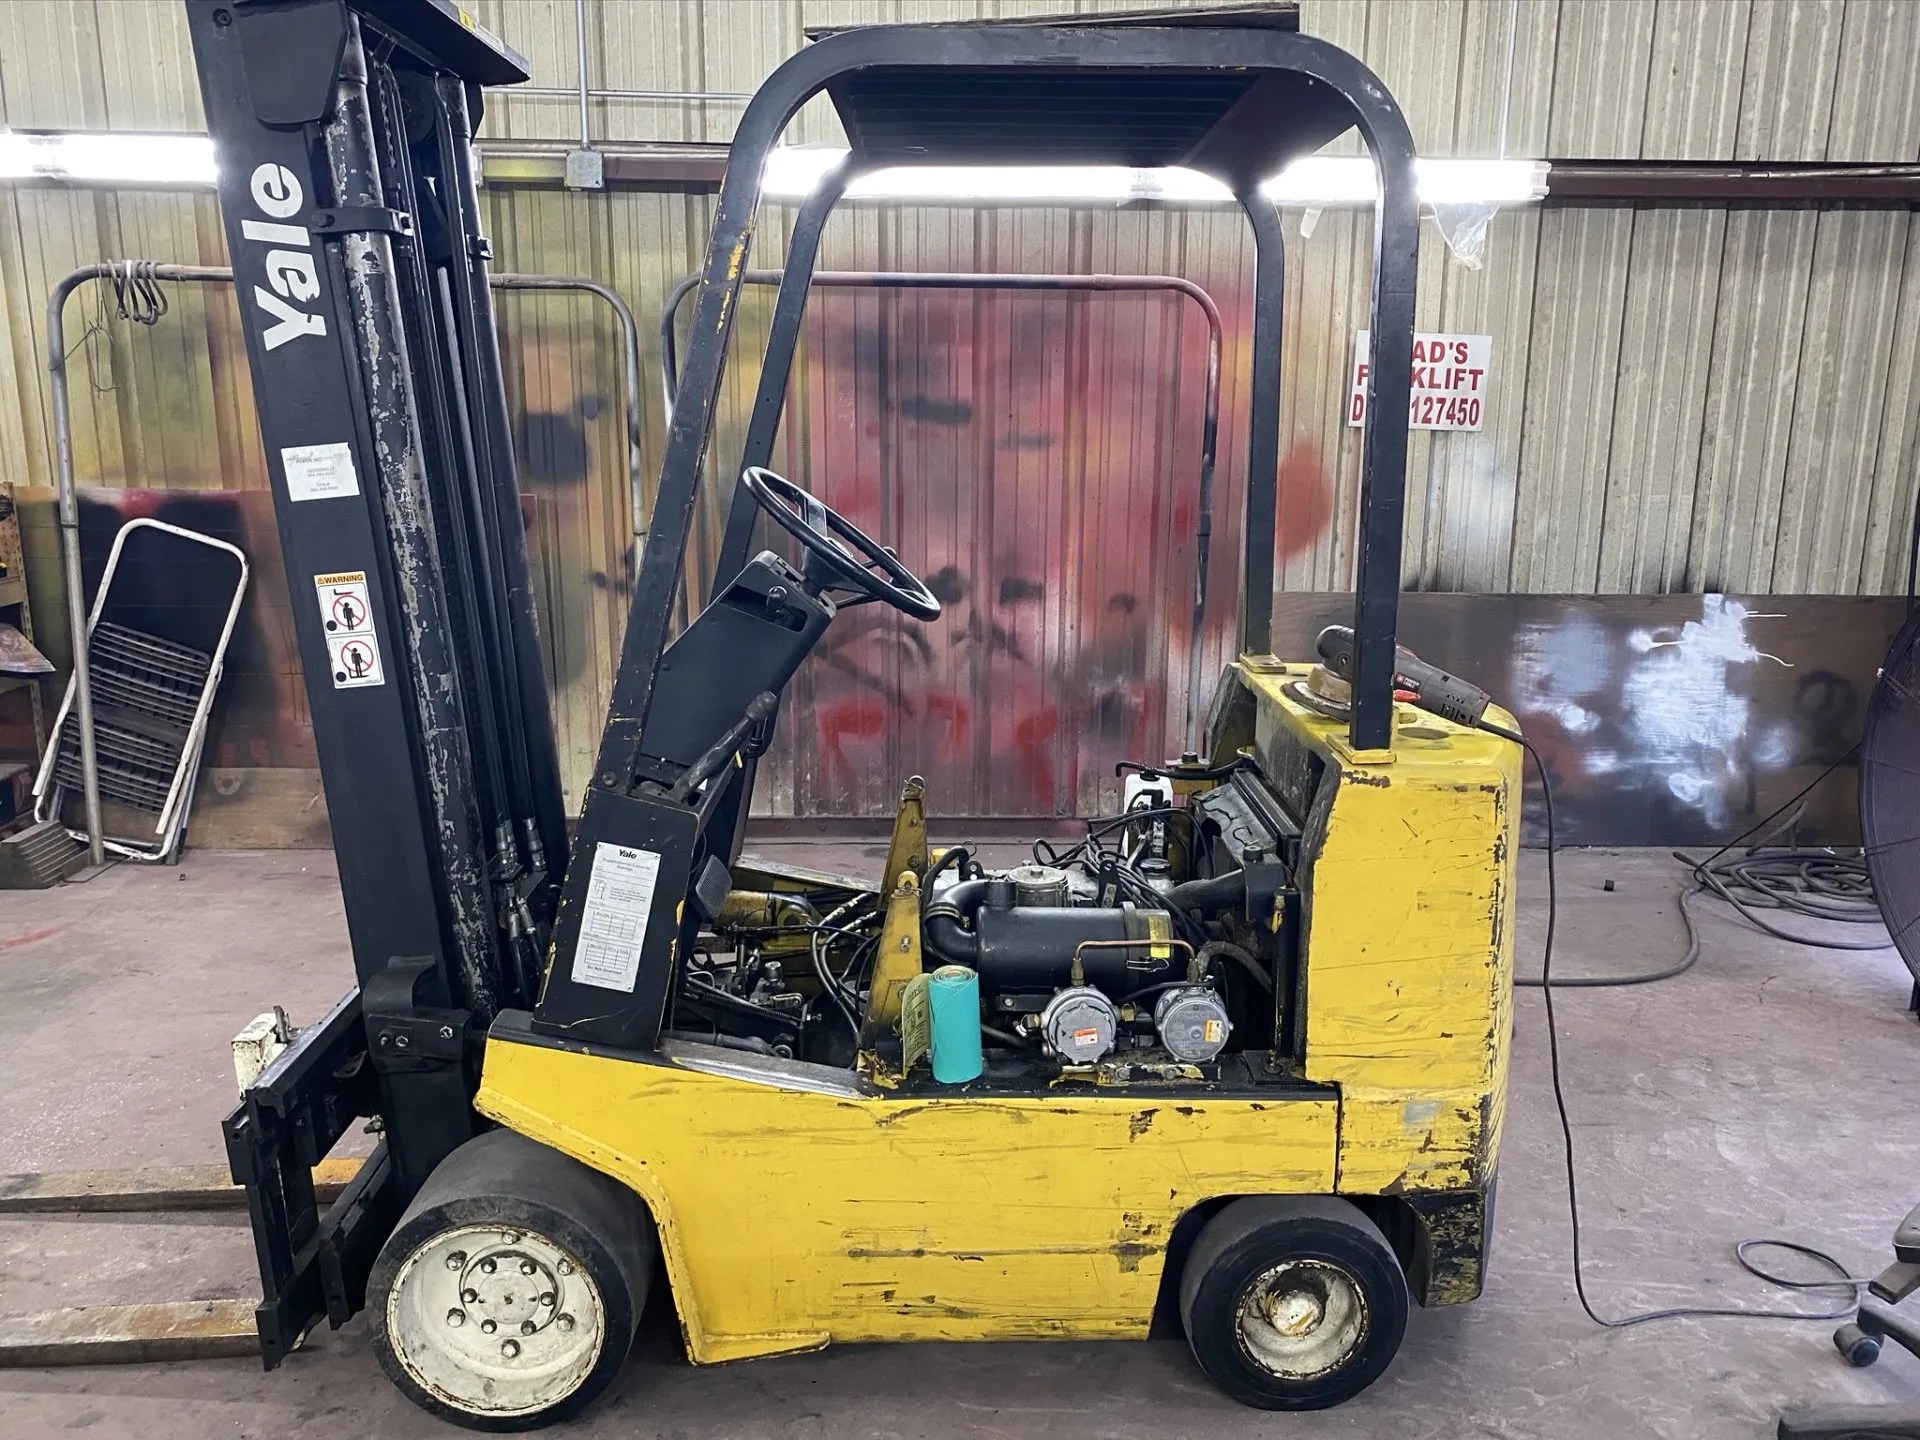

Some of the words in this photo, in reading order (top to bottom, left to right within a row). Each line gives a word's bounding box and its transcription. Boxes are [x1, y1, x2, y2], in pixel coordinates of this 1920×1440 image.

[241, 163, 326, 351] Yale
[1412, 341, 1468, 364] AD'S
[1357, 365, 1483, 390] FKLIFT
[325, 574, 364, 584] WARNING
[619, 849, 637, 859] Yale
